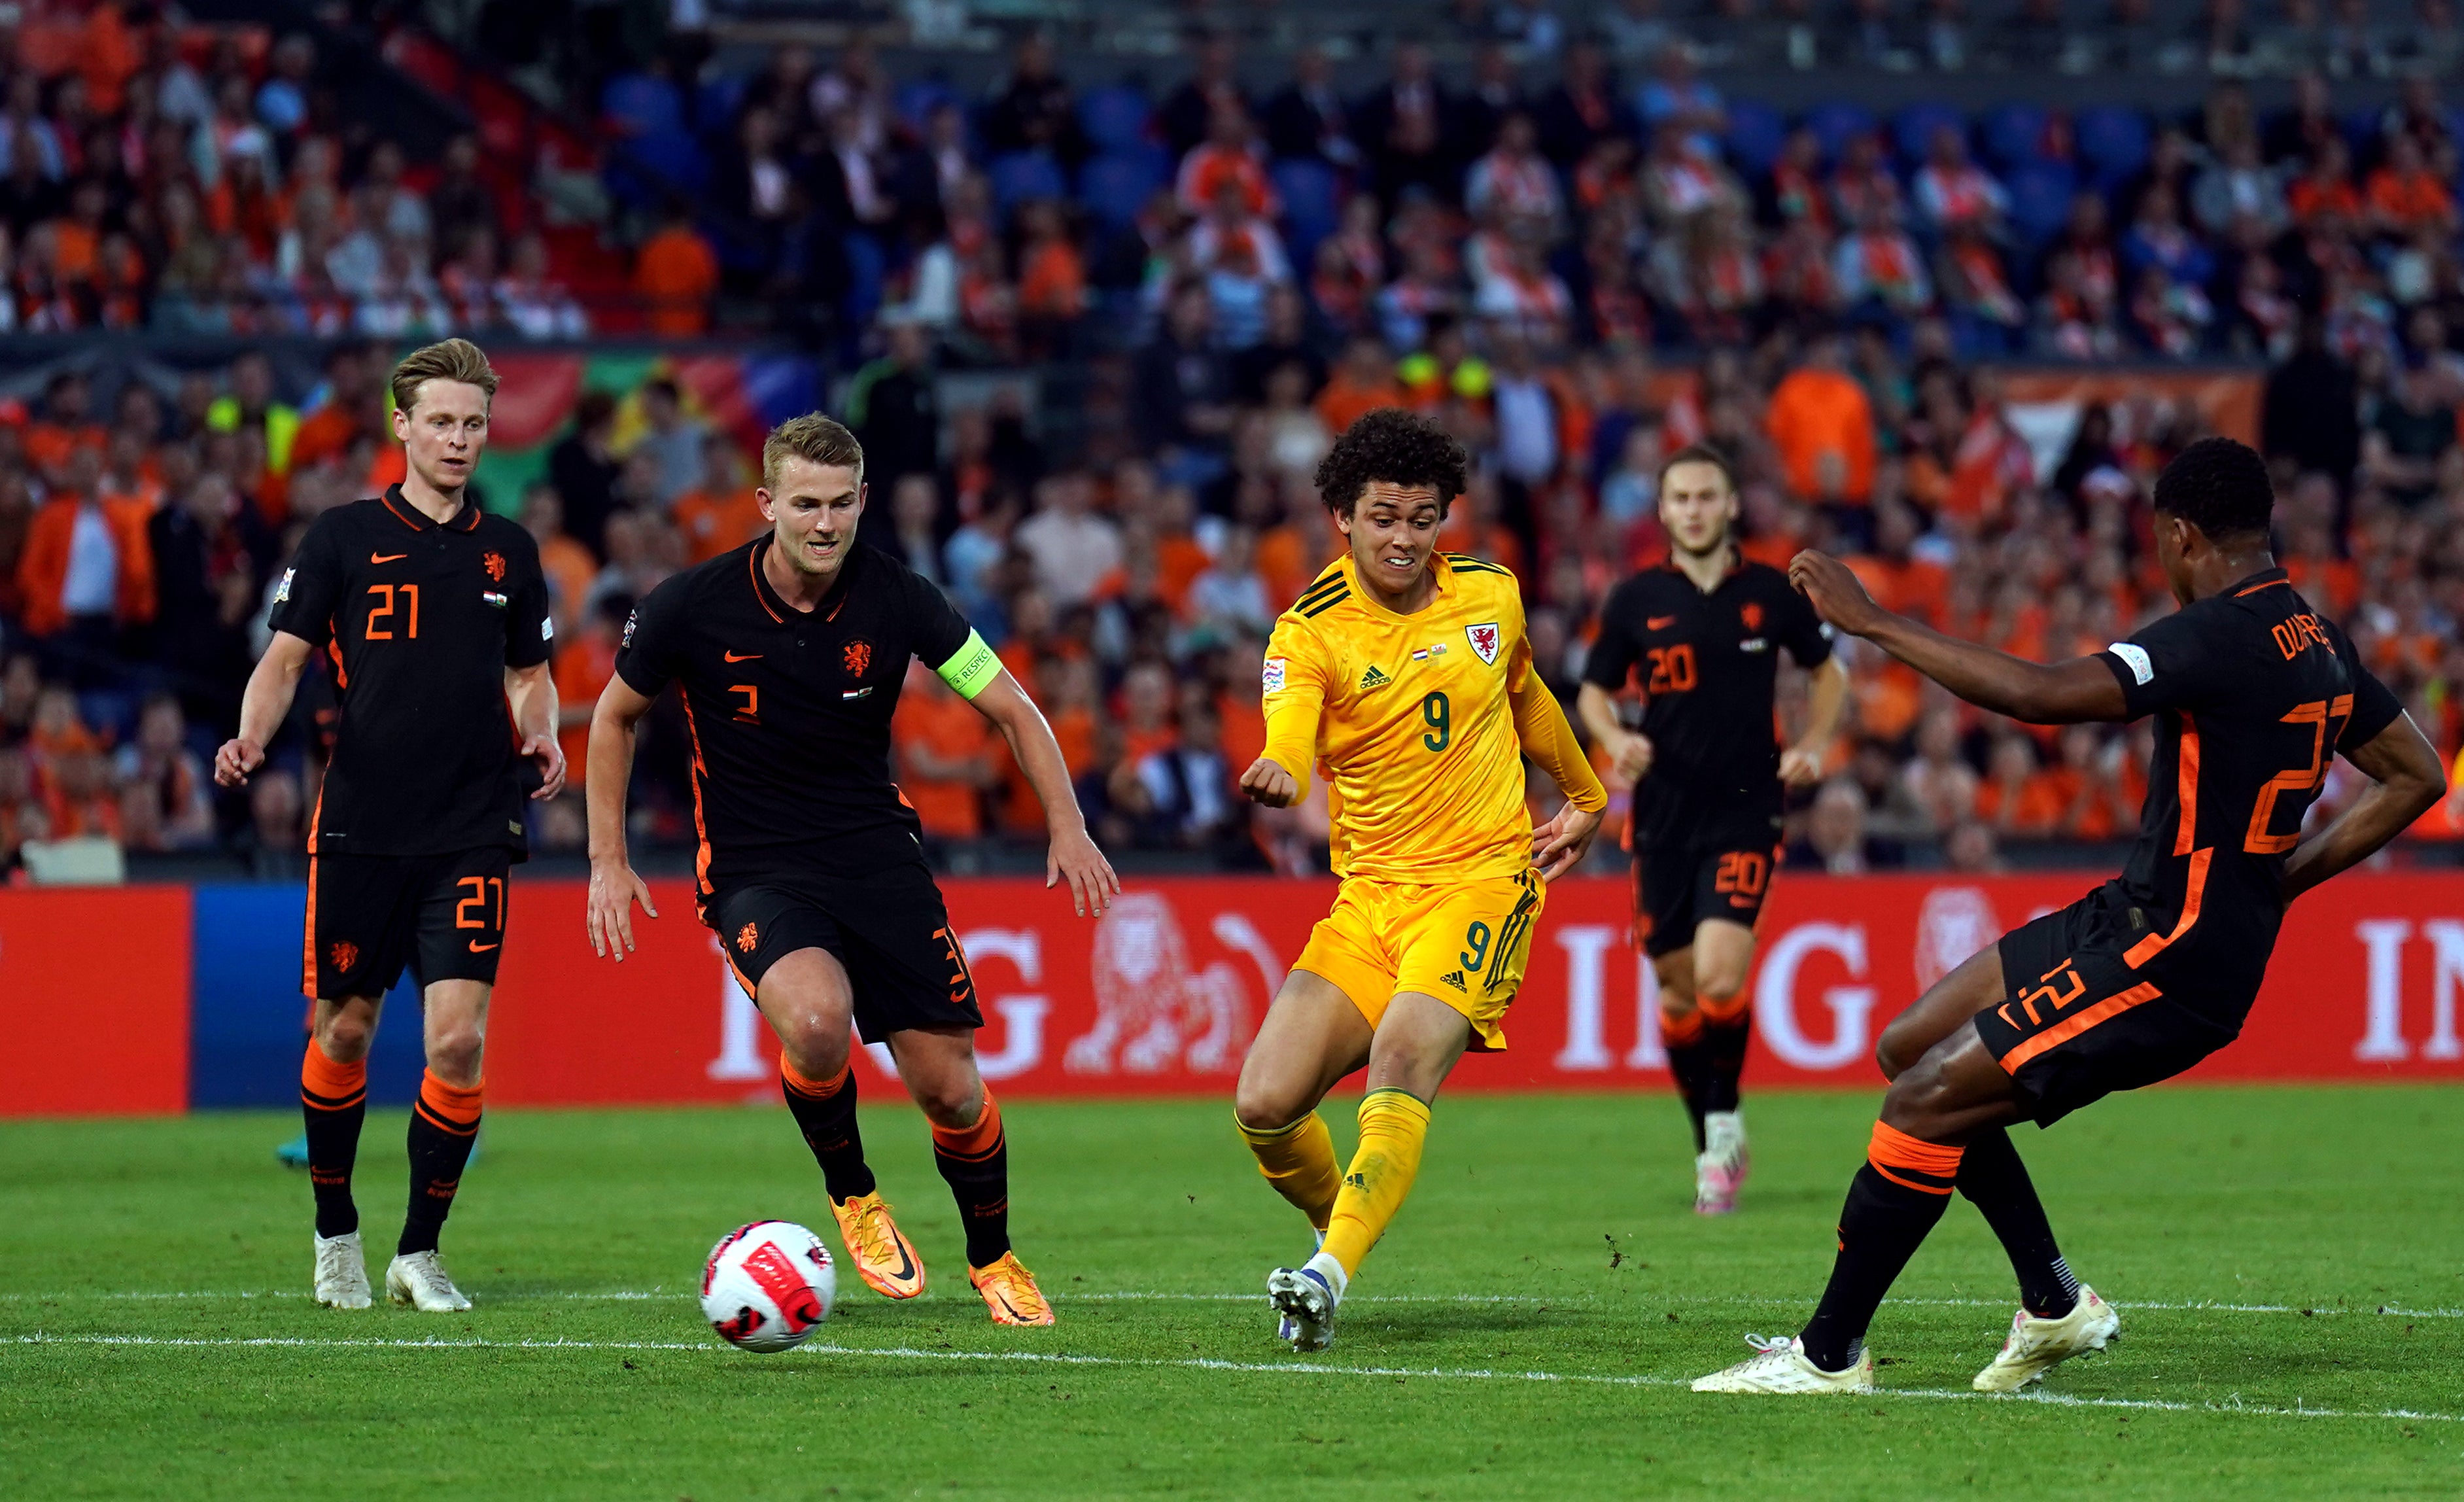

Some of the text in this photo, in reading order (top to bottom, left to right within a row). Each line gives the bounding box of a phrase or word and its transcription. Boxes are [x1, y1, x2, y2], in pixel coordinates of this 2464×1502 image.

[366, 584, 419, 640] 21
[962, 648, 990, 679] RESPECT
[1360, 676, 1391, 690] adidas
[1647, 643, 1698, 693] 20
[1423, 691, 1449, 752] 9
[1715, 851, 1767, 896] 20
[456, 876, 503, 932] 21
[1460, 920, 1491, 972] 9
[706, 929, 1051, 1083] IG
[1440, 975, 1467, 994] adidas
